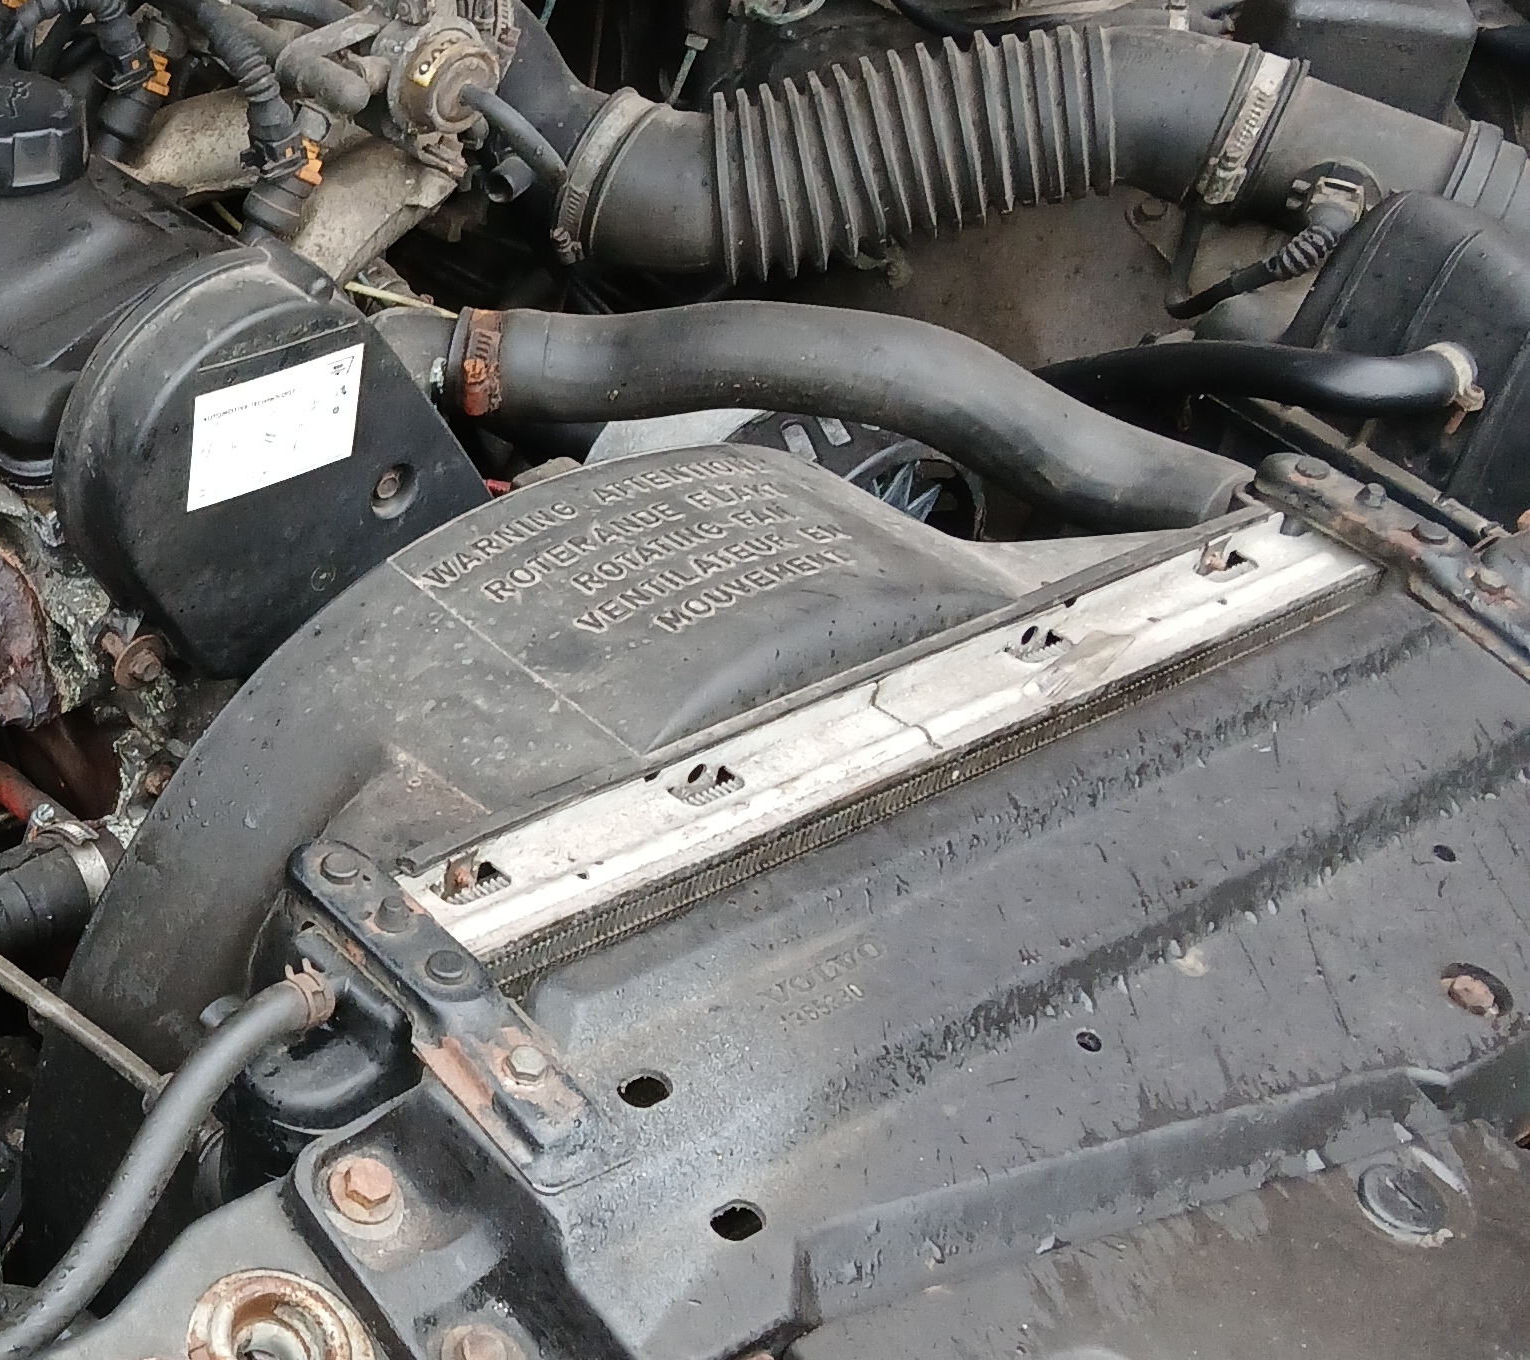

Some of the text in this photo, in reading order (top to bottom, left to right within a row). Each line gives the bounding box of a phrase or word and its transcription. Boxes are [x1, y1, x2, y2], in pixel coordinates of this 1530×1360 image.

[421, 501, 578, 588] WARNING
[483, 501, 686, 602] ROTERANDE
[571, 521, 727, 595] ROTATING
[572, 523, 852, 633] VENTILATEUR EN
[653, 548, 857, 633] MOUVEMENT
[756, 942, 880, 1003] VOLVO
